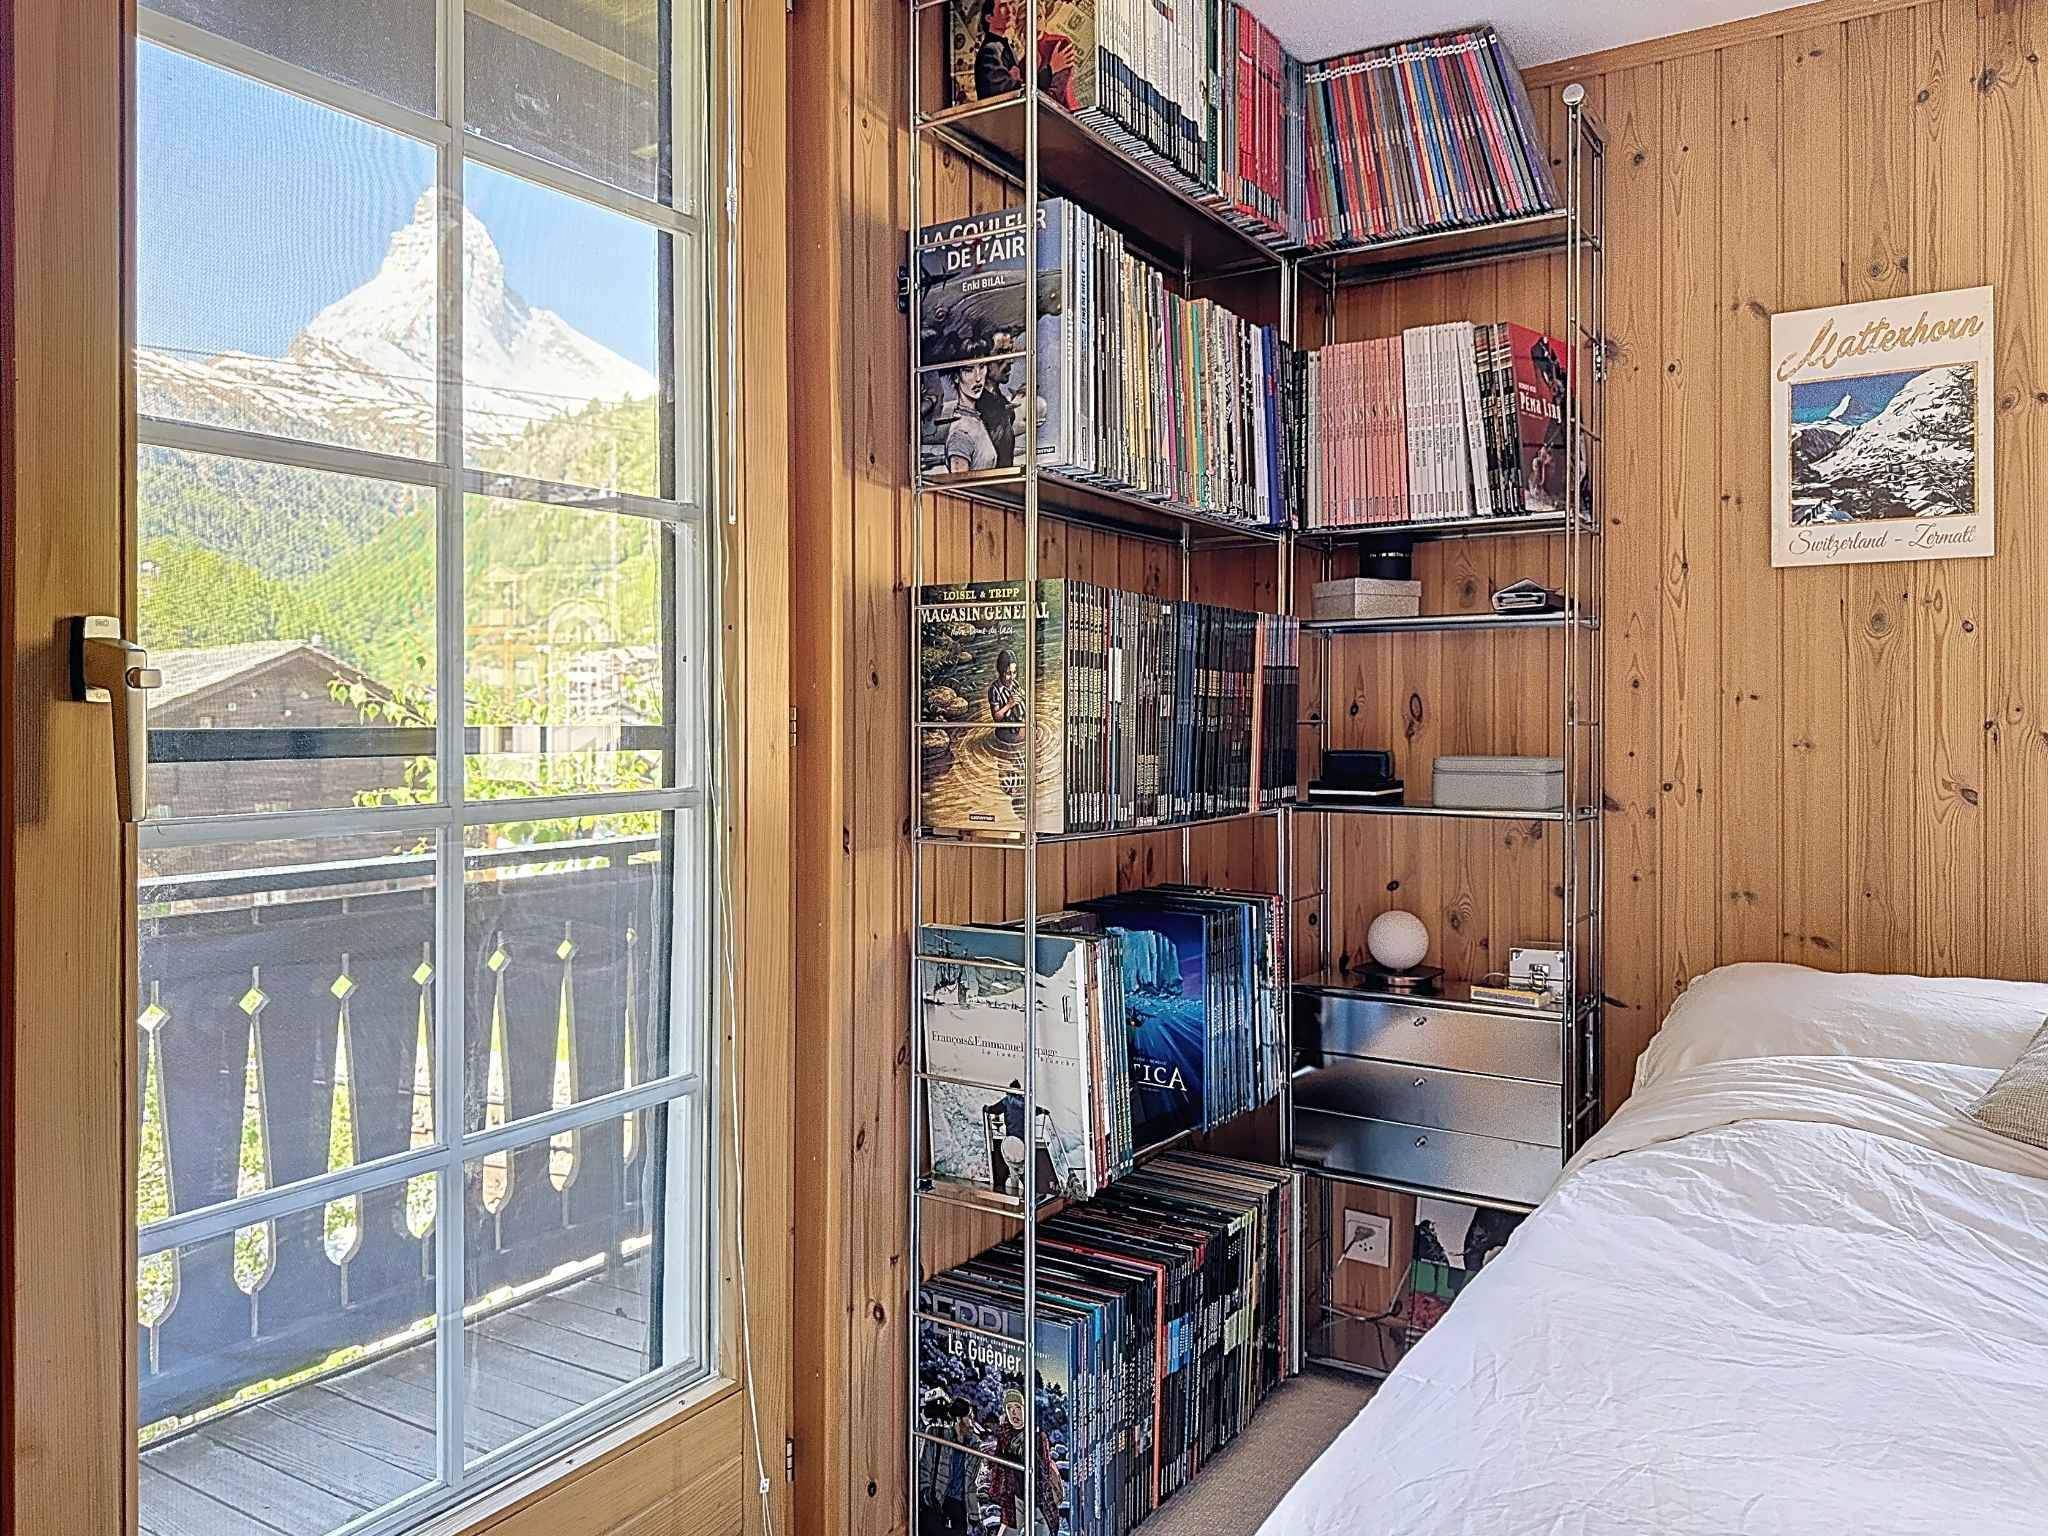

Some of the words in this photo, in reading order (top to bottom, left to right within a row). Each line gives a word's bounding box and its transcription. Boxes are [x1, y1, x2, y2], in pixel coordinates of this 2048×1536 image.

[947, 247, 971, 271] DE
[976, 236, 1026, 265] L'AIR
[962, 280, 981, 292] Enki
[981, 275, 1006, 288] BILAL
[1777, 310, 1984, 382] Matterhorn
[1789, 530, 1889, 559] Switzerland
[1908, 523, 1977, 549] Zermatt
[943, 589, 977, 601] LOISEL
[979, 590, 986, 599] &
[988, 587, 1020, 599] TRIPP
[921, 605, 981, 624] MAGASIN
[948, 1333, 963, 1357] Le
[968, 1338, 1022, 1373] Guêpier
